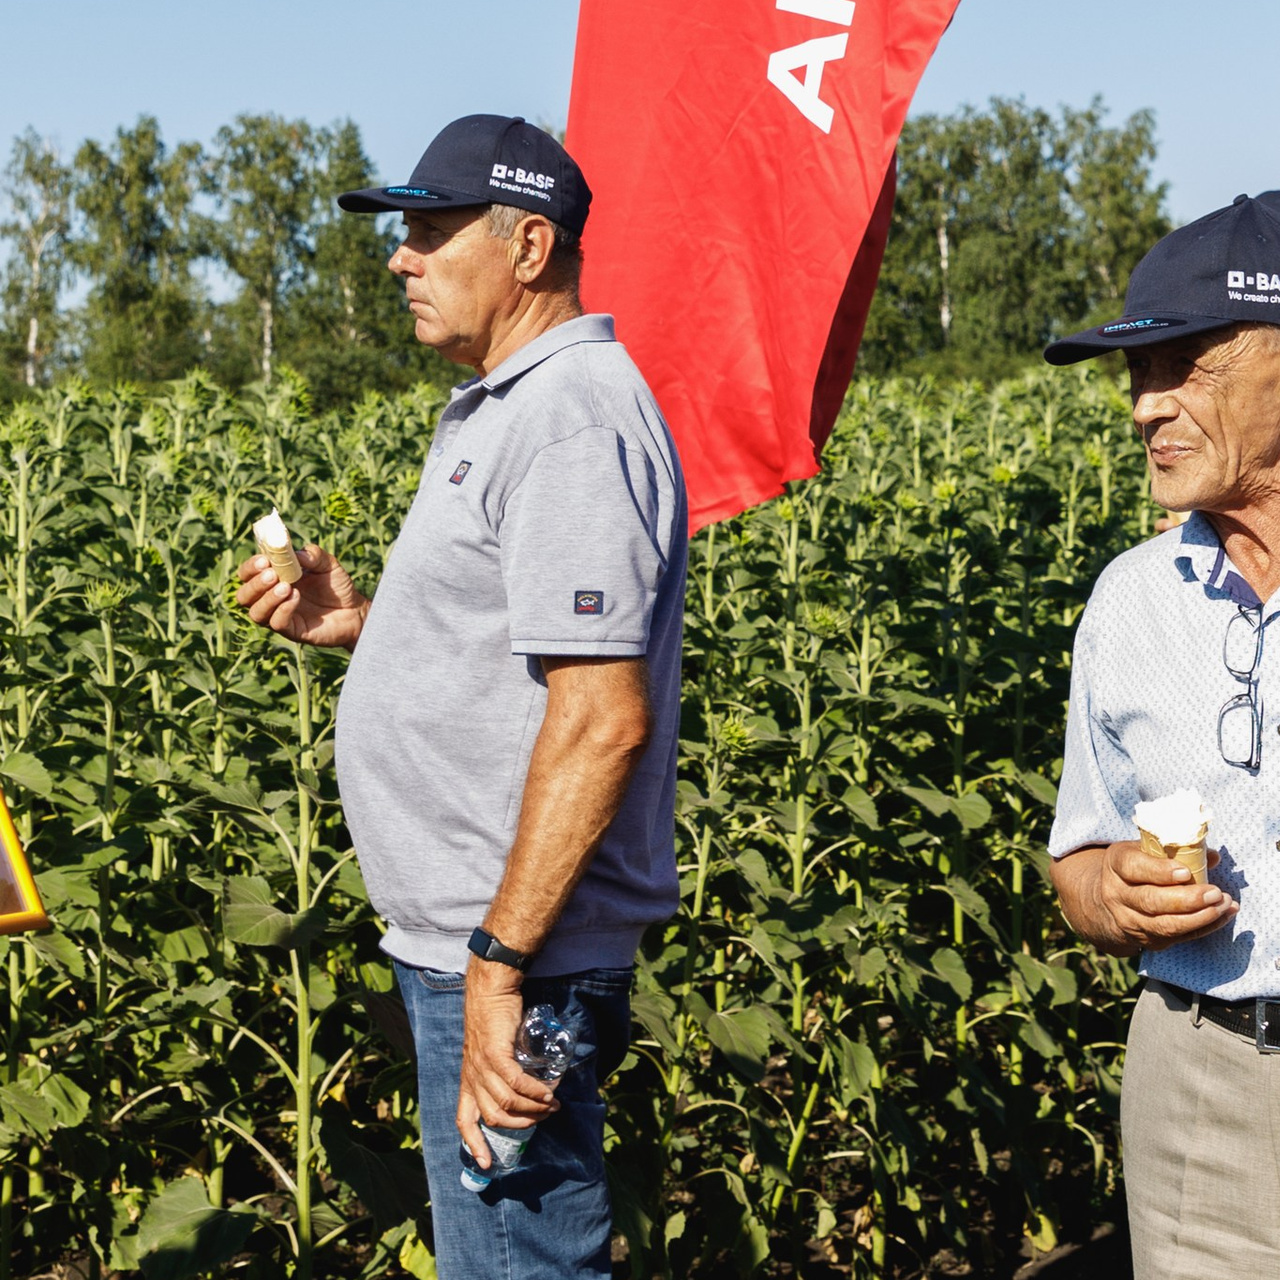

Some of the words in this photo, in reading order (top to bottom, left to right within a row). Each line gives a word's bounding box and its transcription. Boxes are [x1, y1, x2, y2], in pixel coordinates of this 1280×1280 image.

[515, 167, 555, 190] BASF
[489, 178, 500, 187] We
[501, 182, 522, 193] create
[522, 187, 551, 202] chemistry
[1228, 290, 1242, 300] We
[1243, 293, 1269, 303] create
[1104, 319, 1153, 332] IMPACT
